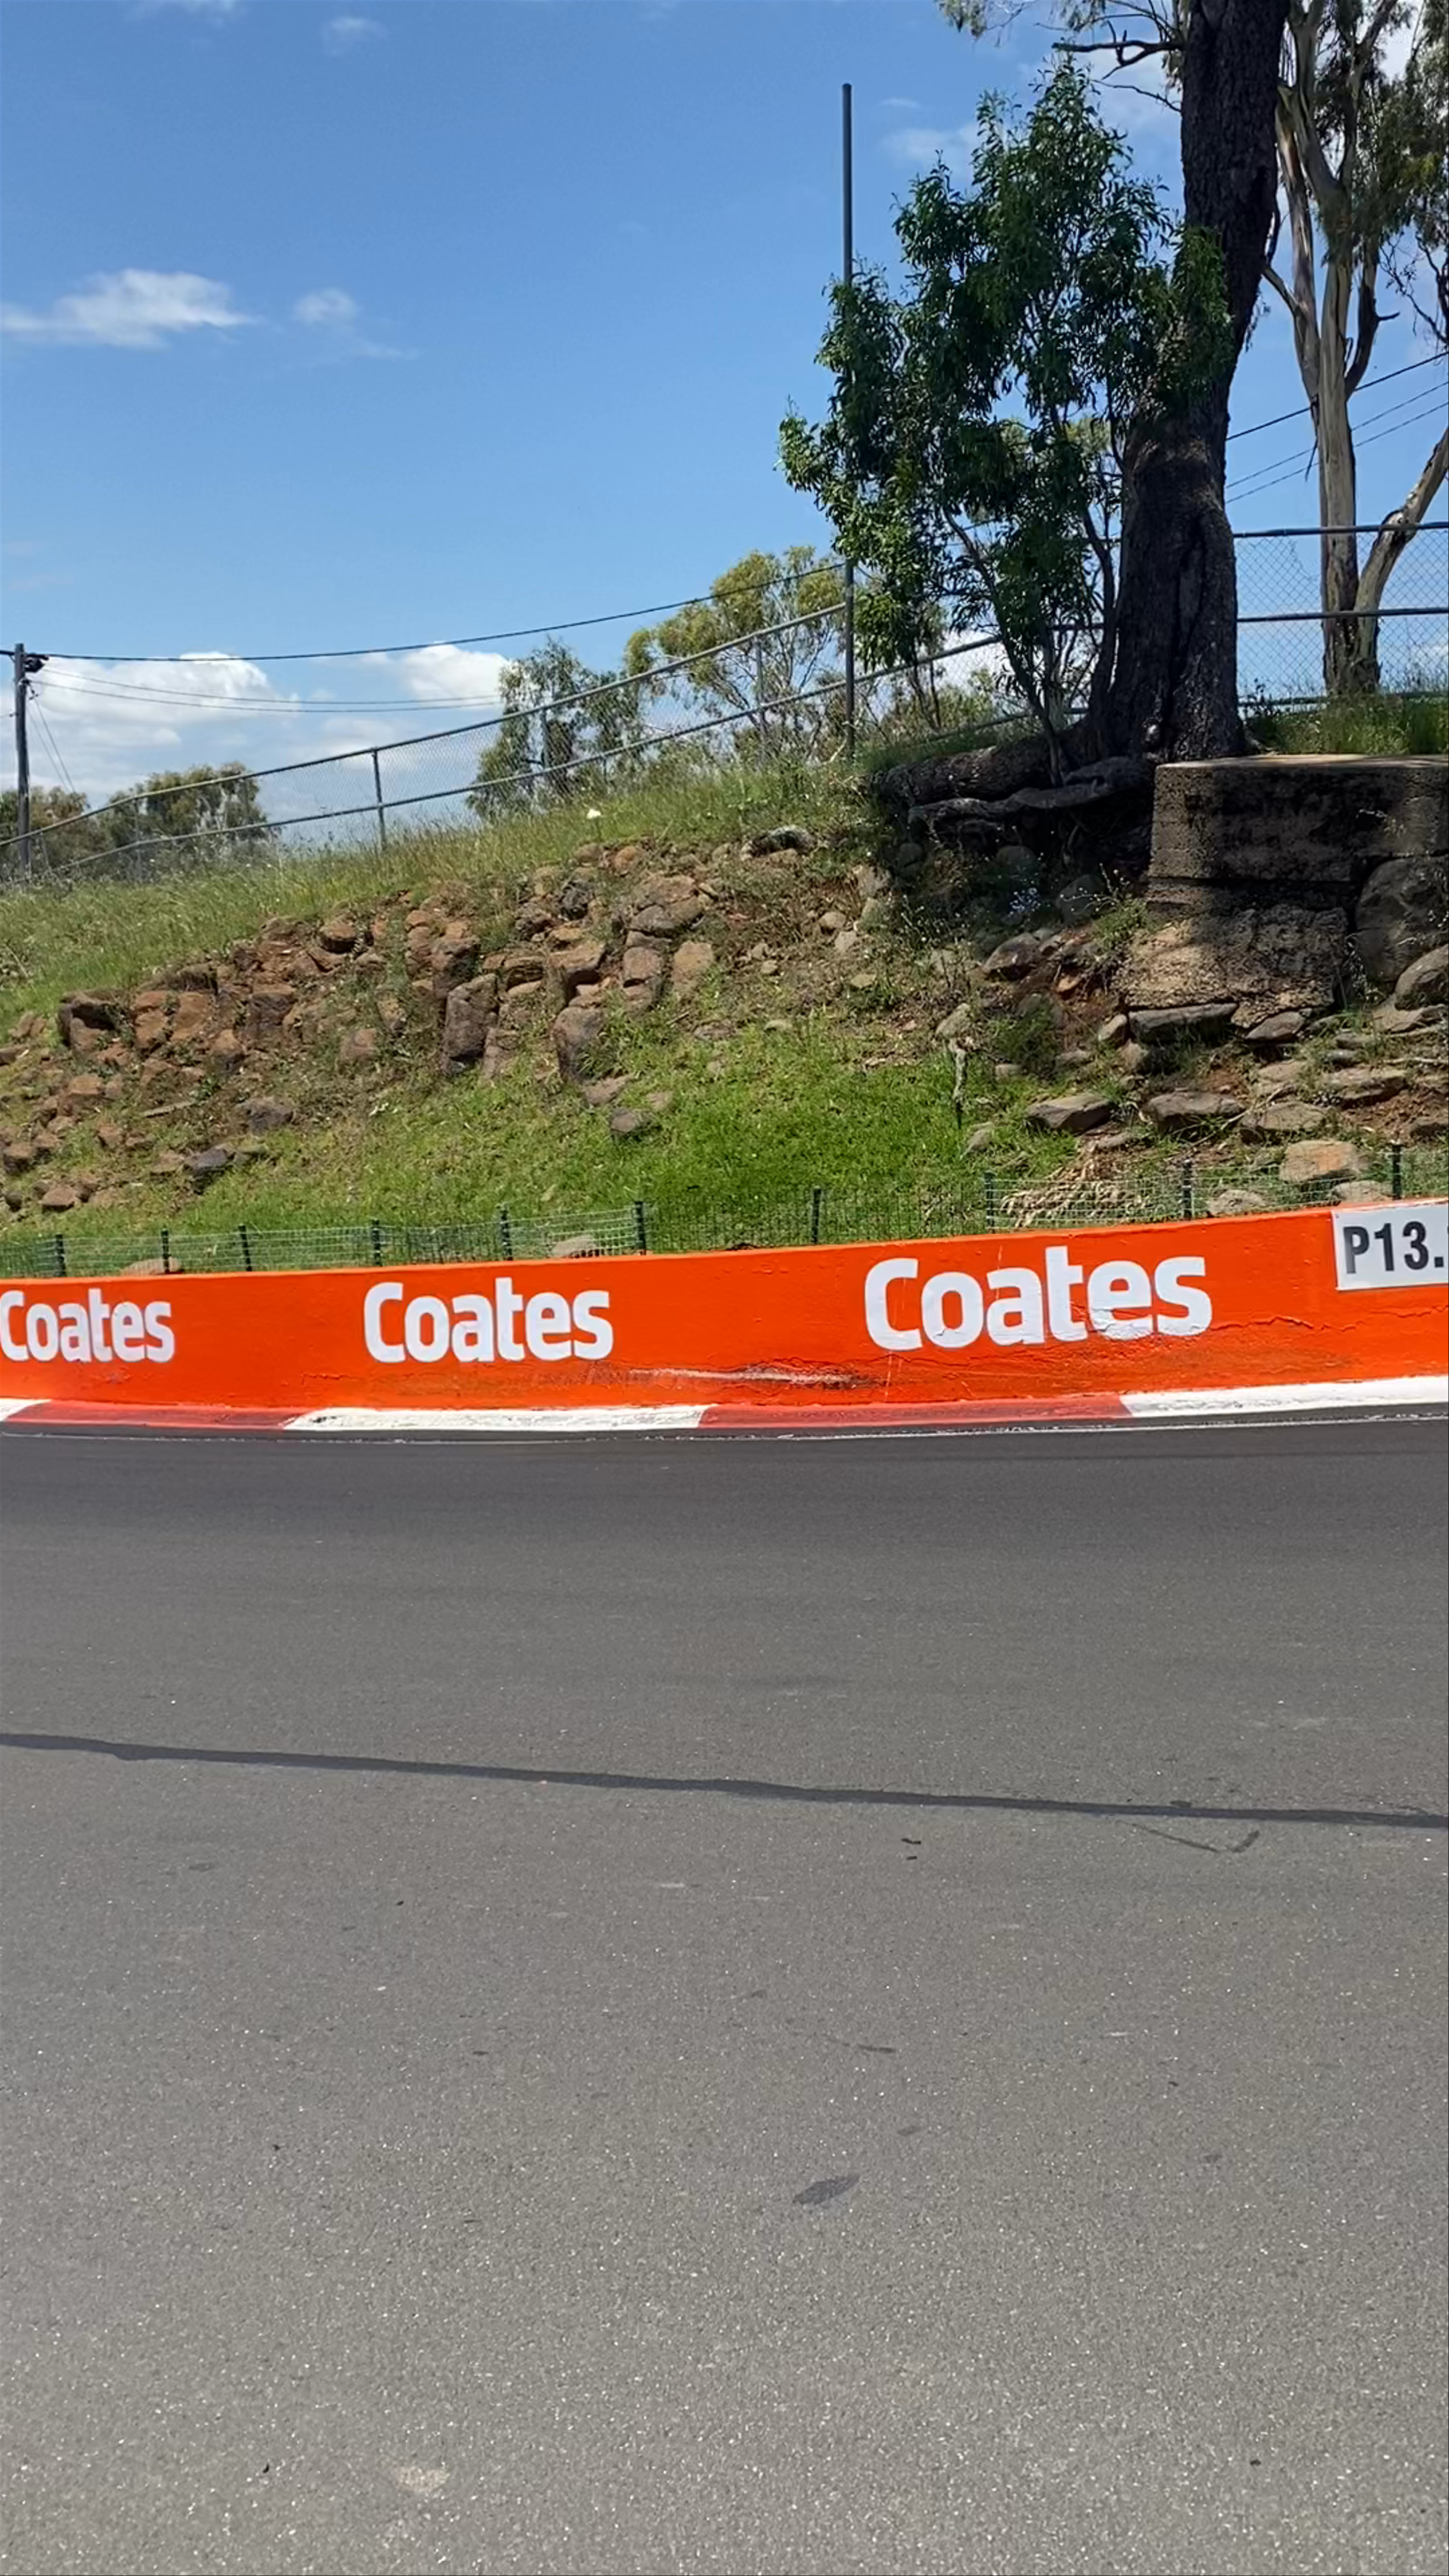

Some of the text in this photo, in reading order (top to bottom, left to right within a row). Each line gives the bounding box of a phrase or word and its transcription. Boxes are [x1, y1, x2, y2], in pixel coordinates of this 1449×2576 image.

[1343, 1221, 1449, 1274] P13.
[0, 1288, 175, 1363] Coates
[364, 1277, 614, 1363] Coates
[864, 1246, 1213, 1351] Coates
